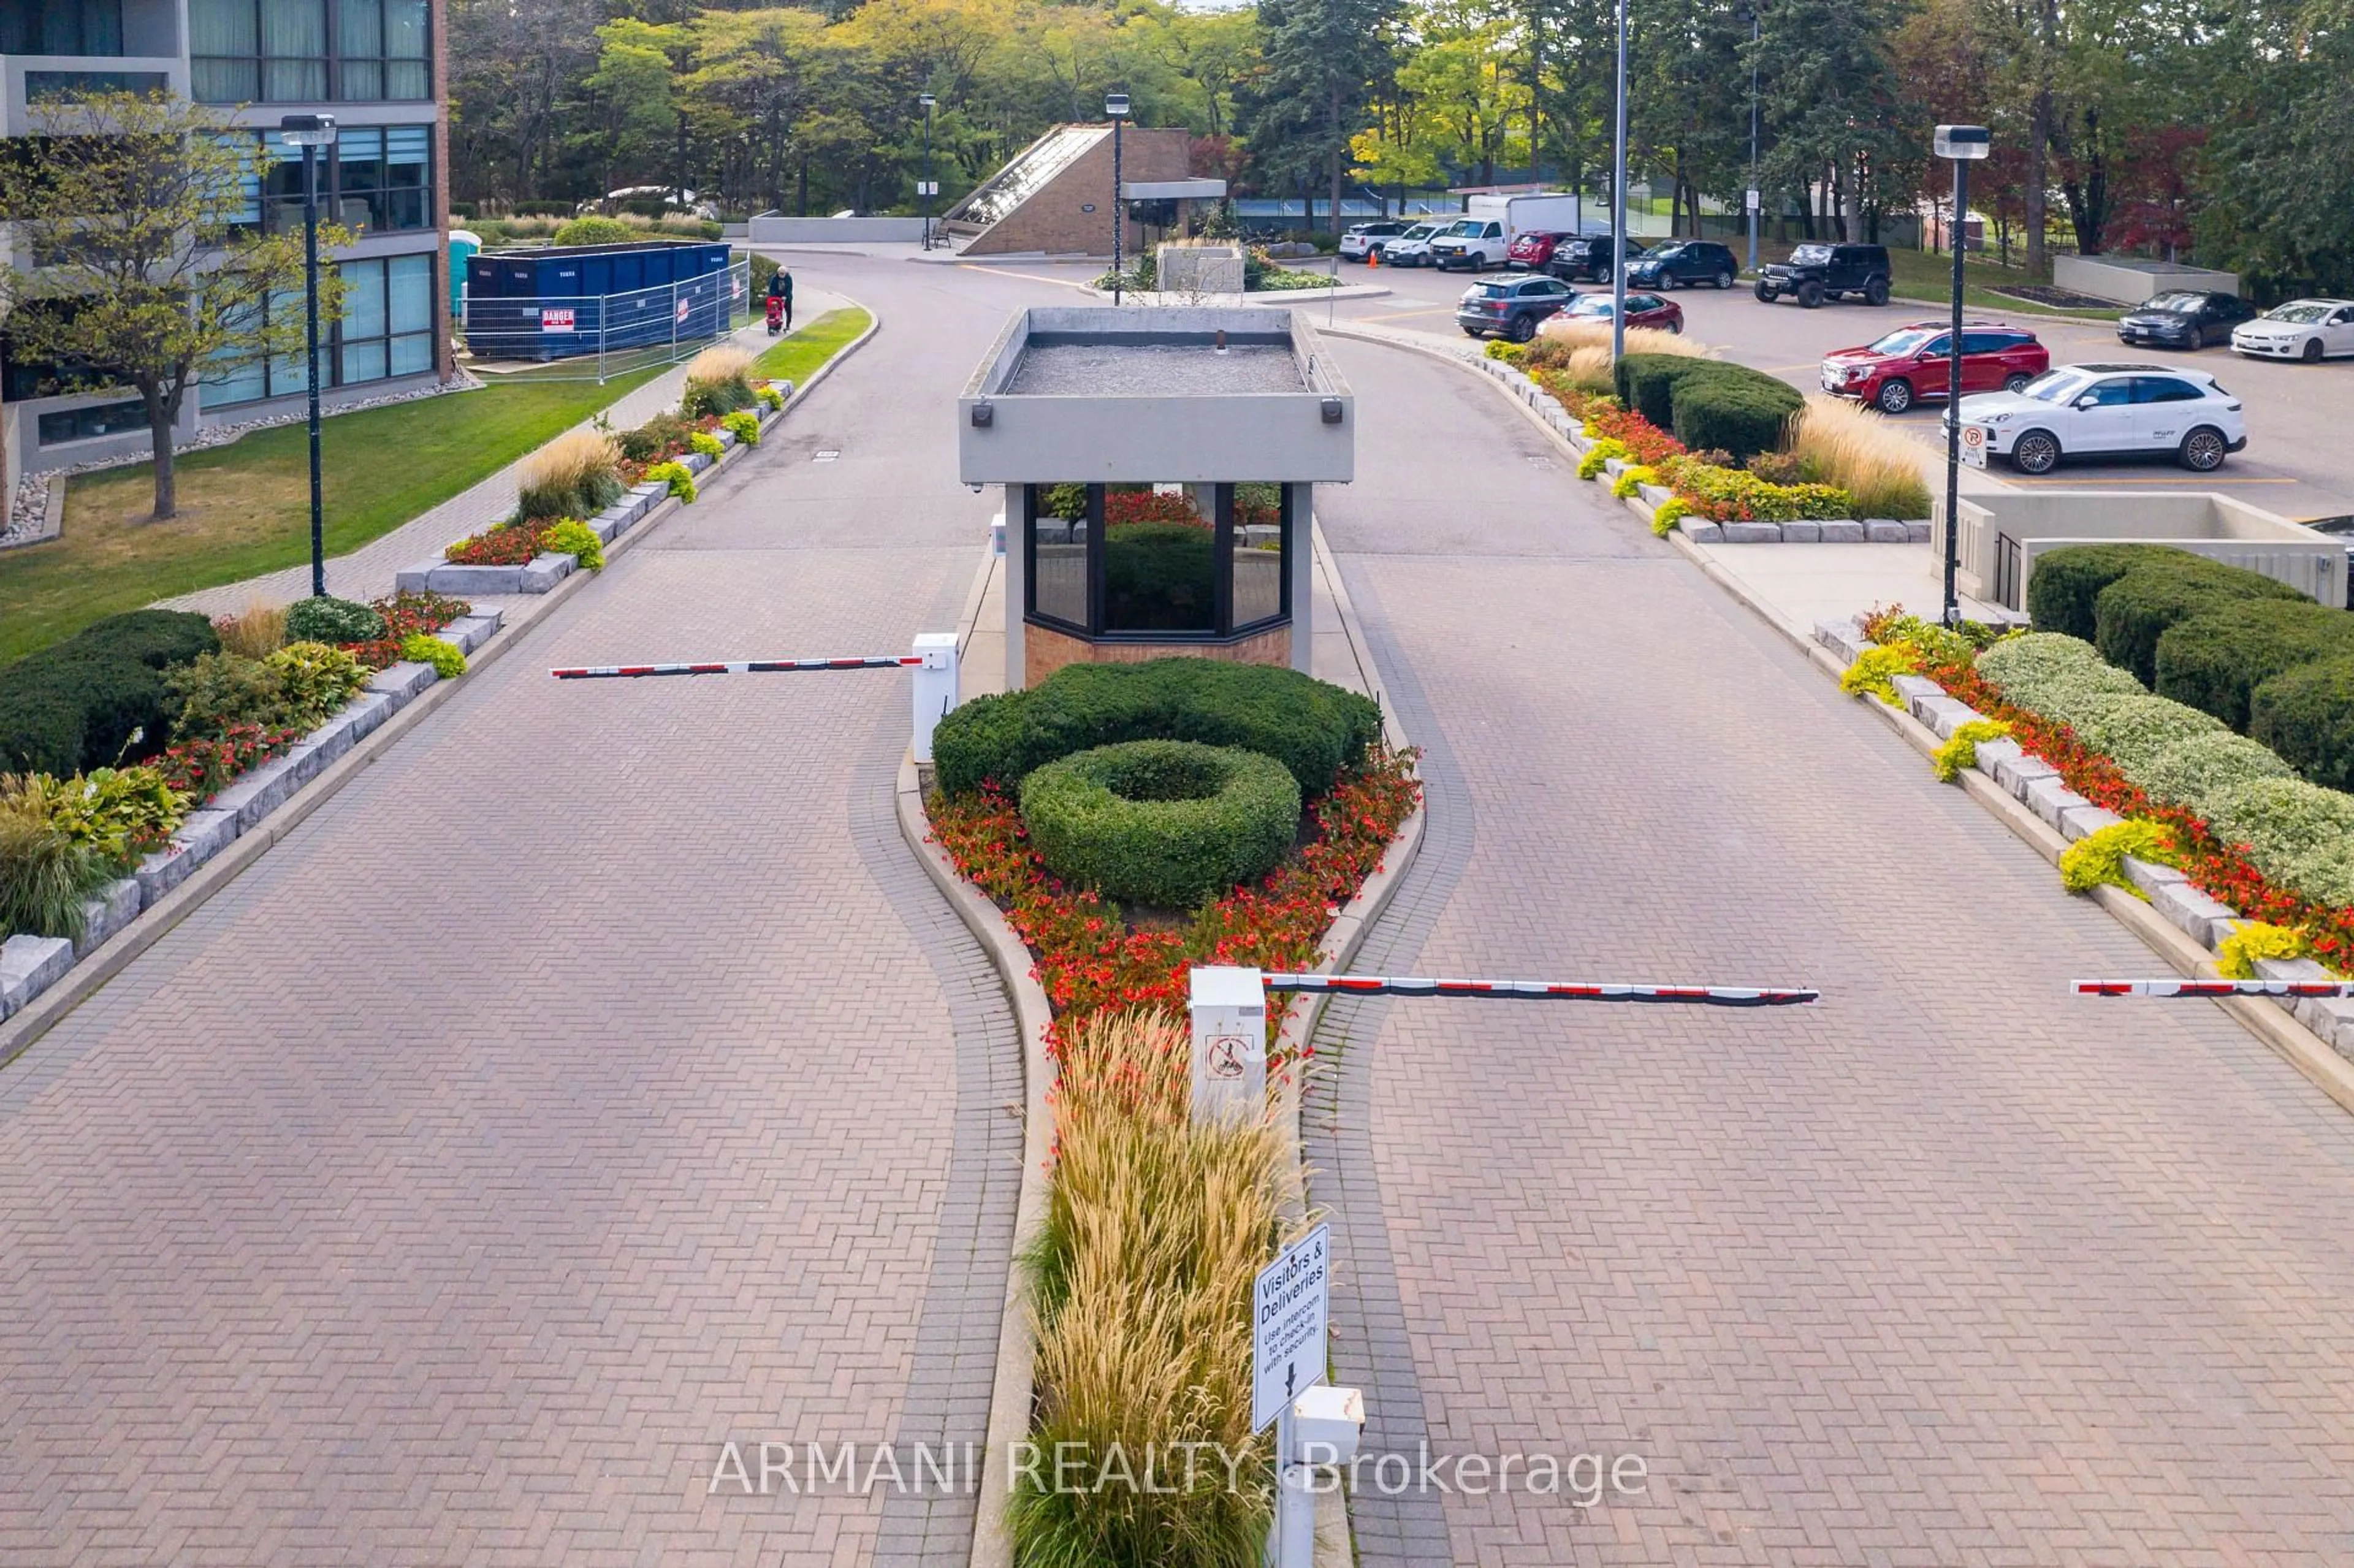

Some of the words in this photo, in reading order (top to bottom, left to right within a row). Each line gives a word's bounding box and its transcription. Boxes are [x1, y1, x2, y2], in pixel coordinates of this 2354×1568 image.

[1262, 1265, 1323, 1325] Deliveries
[1263, 1253, 1309, 1299] Visitors
[1314, 1241, 1322, 1260] &
[1264, 1326, 1281, 1345] Use
[1283, 1294, 1320, 1330] intercom
[1268, 1344, 1277, 1356] to
[1280, 1312, 1315, 1347] check-in
[1264, 1354, 1282, 1374] with
